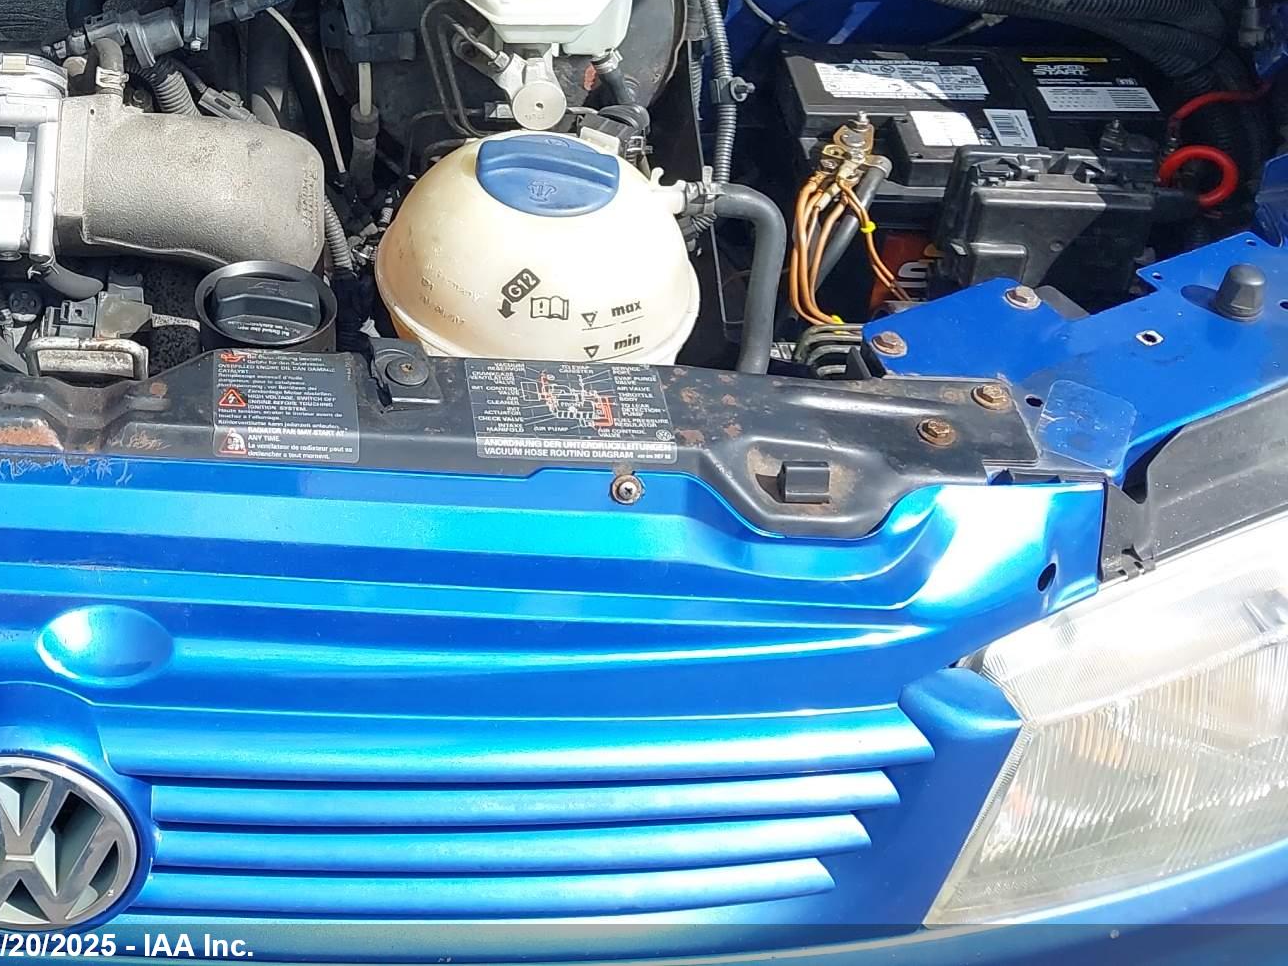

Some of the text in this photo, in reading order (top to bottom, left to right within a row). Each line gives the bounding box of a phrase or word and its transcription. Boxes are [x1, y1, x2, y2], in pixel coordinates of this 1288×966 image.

[508, 272, 537, 298] G12
[611, 301, 642, 317] max
[614, 334, 641, 350] min
[484, 439, 673, 451] ANORDNUNG DER UNTERDRUCKLEITUNGEN
[484, 447, 523, 456] VACUUM
[525, 449, 549, 457] HOSE
[550, 450, 591, 458] ROUTING
[592, 451, 634, 459] DIAGRAM
